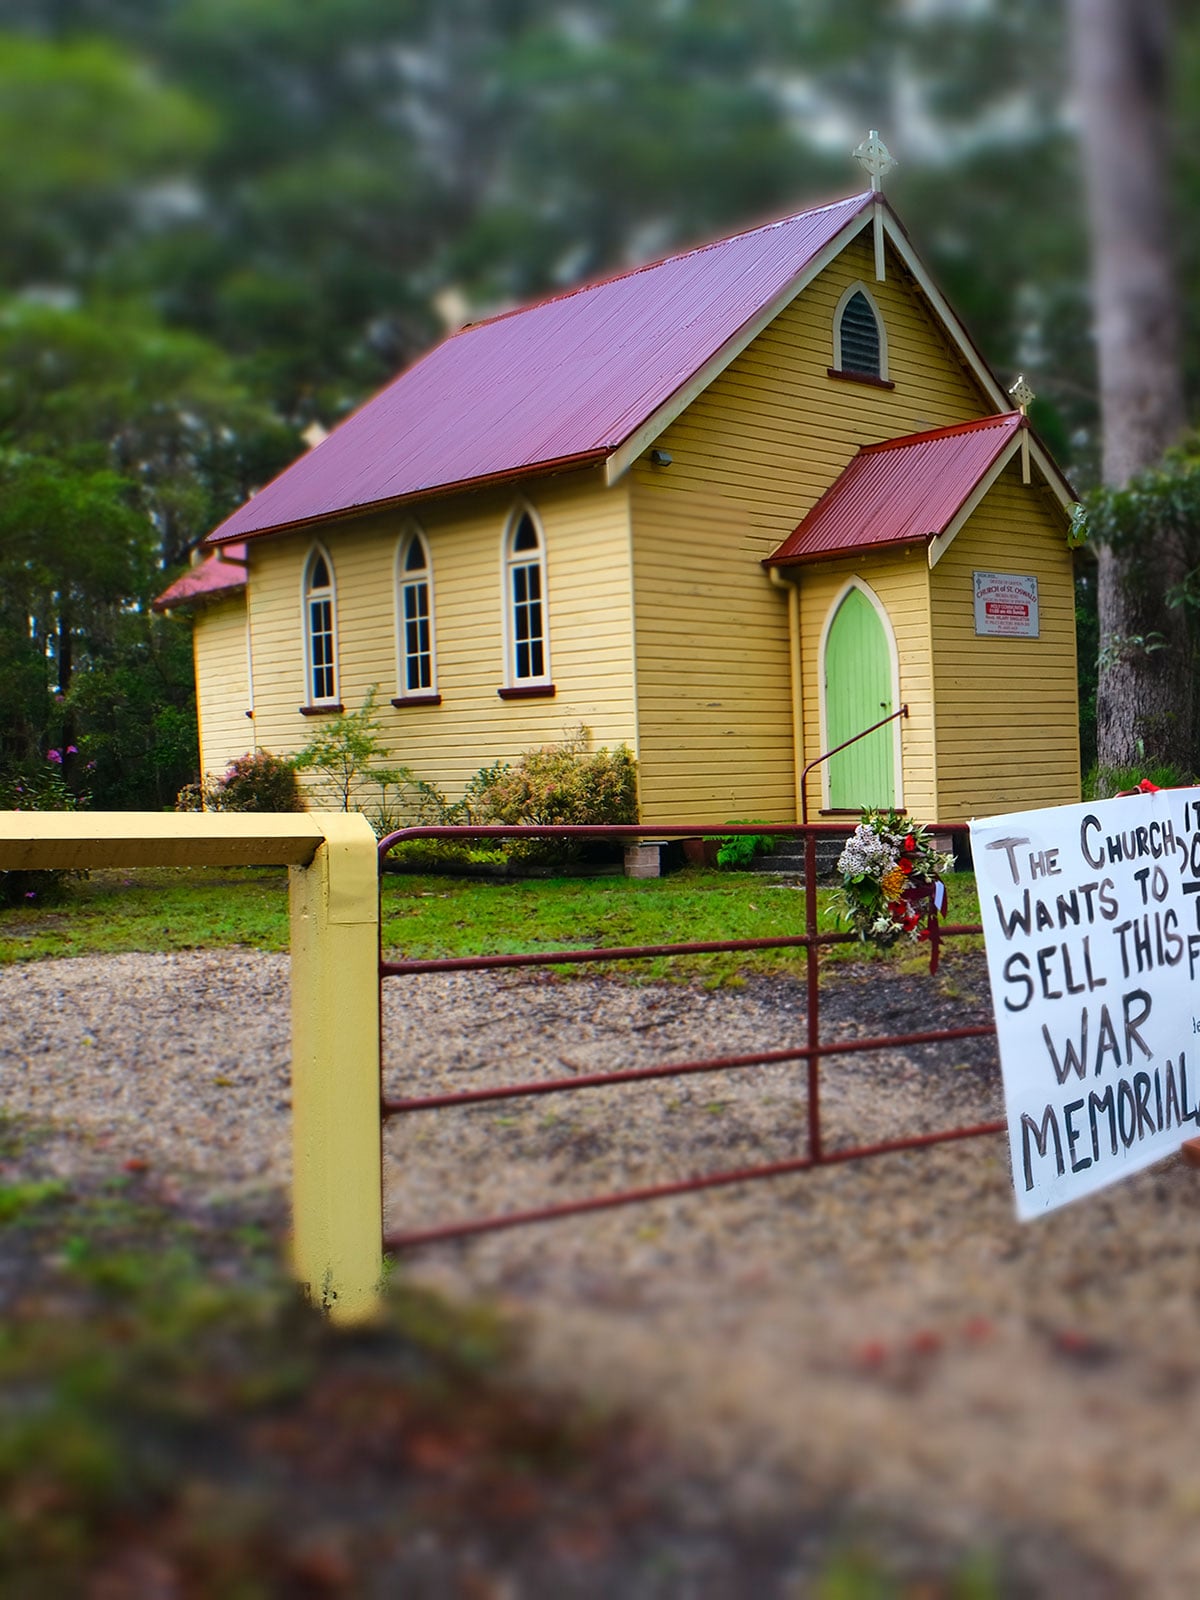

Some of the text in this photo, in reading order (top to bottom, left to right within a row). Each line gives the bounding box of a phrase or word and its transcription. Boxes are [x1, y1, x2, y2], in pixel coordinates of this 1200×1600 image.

[985, 814, 1176, 885] THE CHURCH
[993, 864, 1169, 941] WANTS TO
[1003, 908, 1184, 1012] SELL THIS
[1041, 988, 1154, 1085] WAR
[1020, 1052, 1196, 1192] MEMORIAL
